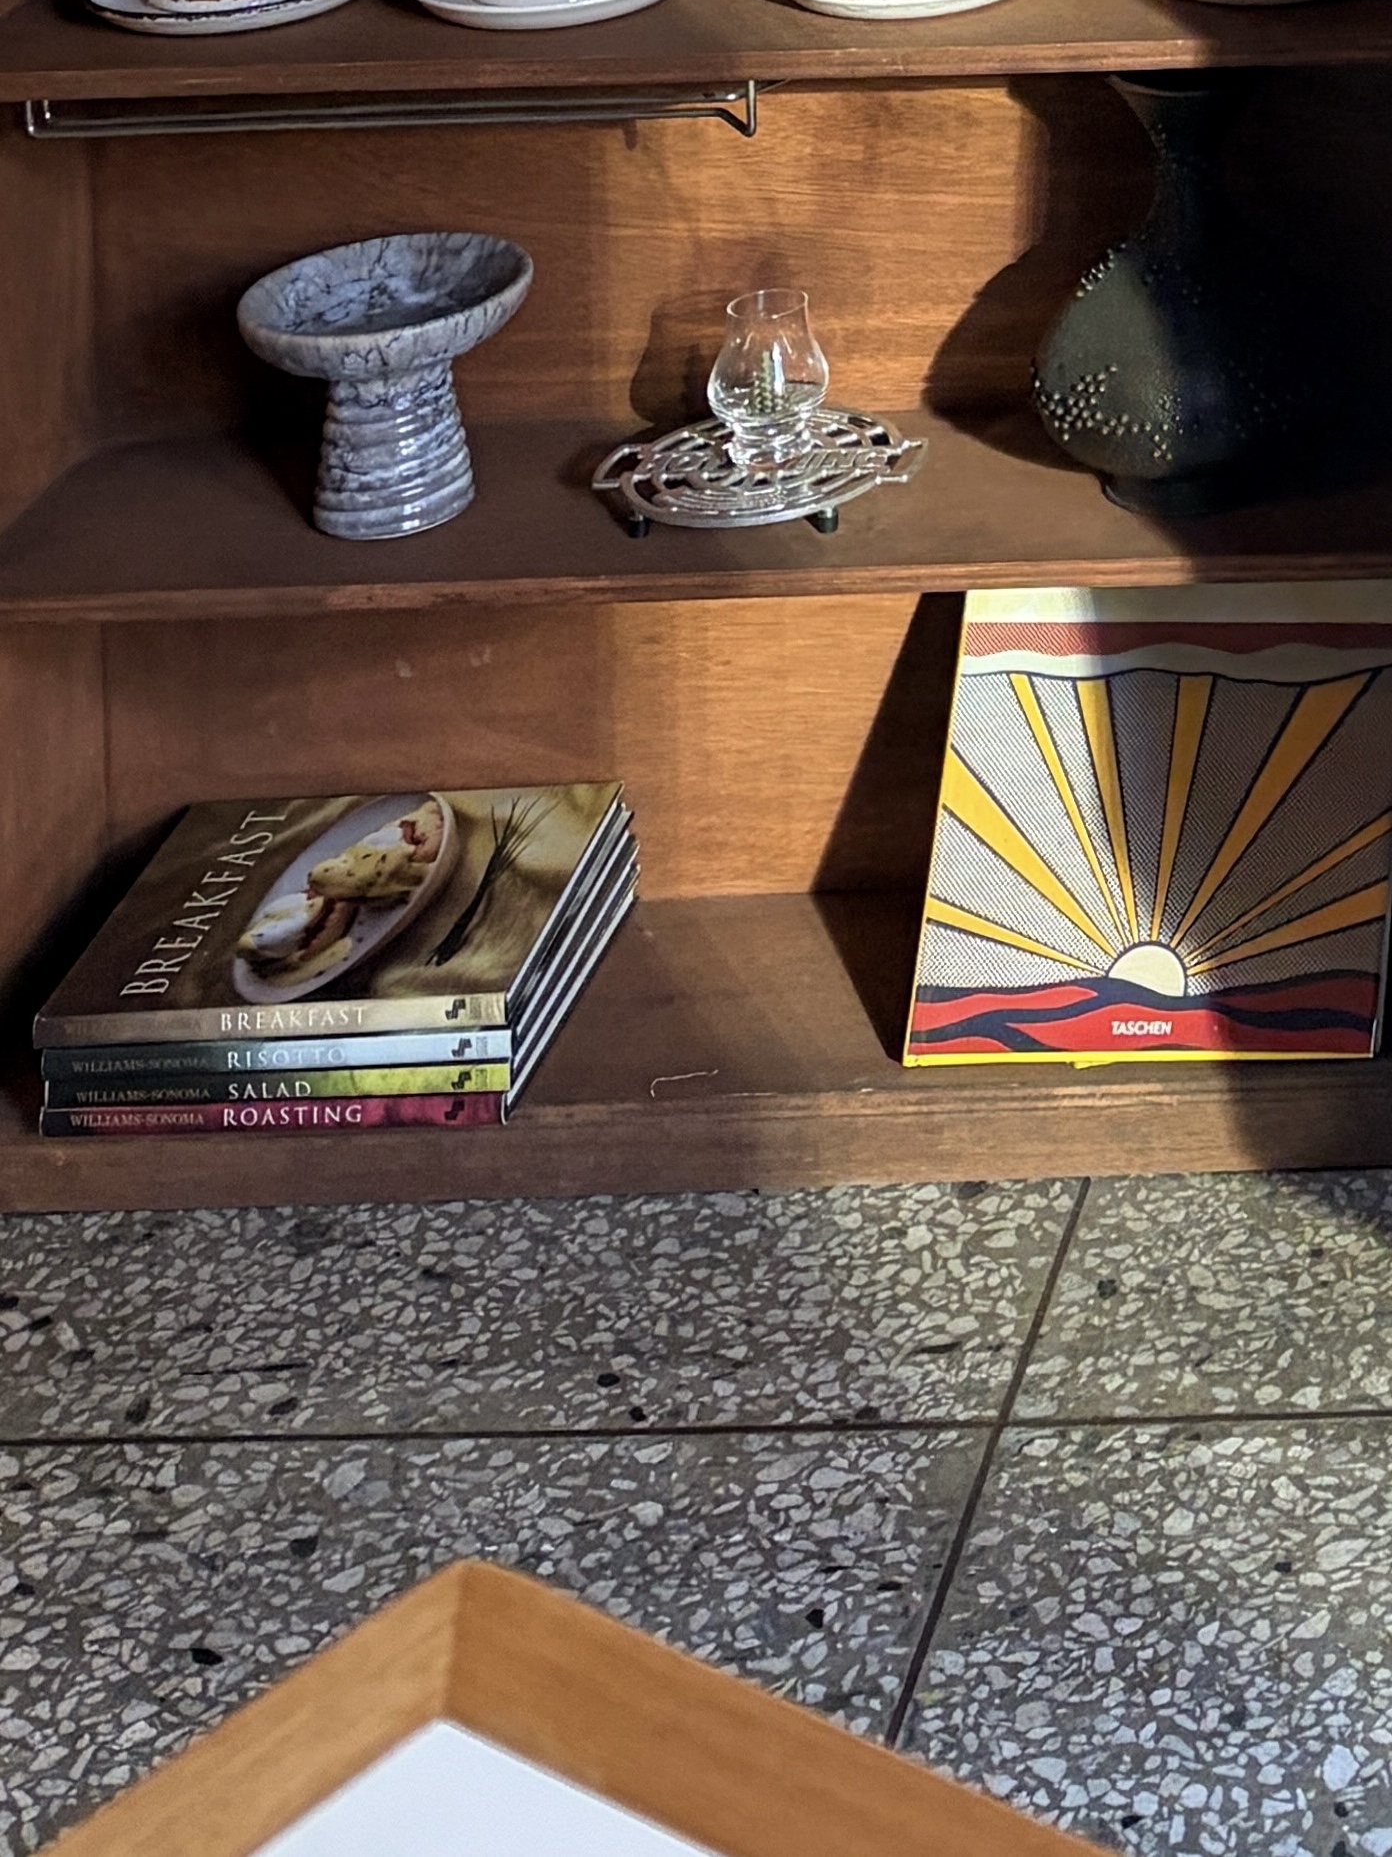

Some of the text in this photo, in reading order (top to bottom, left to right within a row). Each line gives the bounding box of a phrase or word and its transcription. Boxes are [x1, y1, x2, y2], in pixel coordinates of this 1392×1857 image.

[119, 808, 288, 1000] BREAKFAST
[220, 1005, 367, 1033] BREAKFAST
[1111, 1019, 1173, 1037] TASCHEN
[226, 1044, 347, 1070] RISOTTO
[76, 1079, 312, 1105] WILLIAMS-SONOMA SALAD
[69, 1103, 363, 1128] WILLIAMS-SONOMA ROASTING
